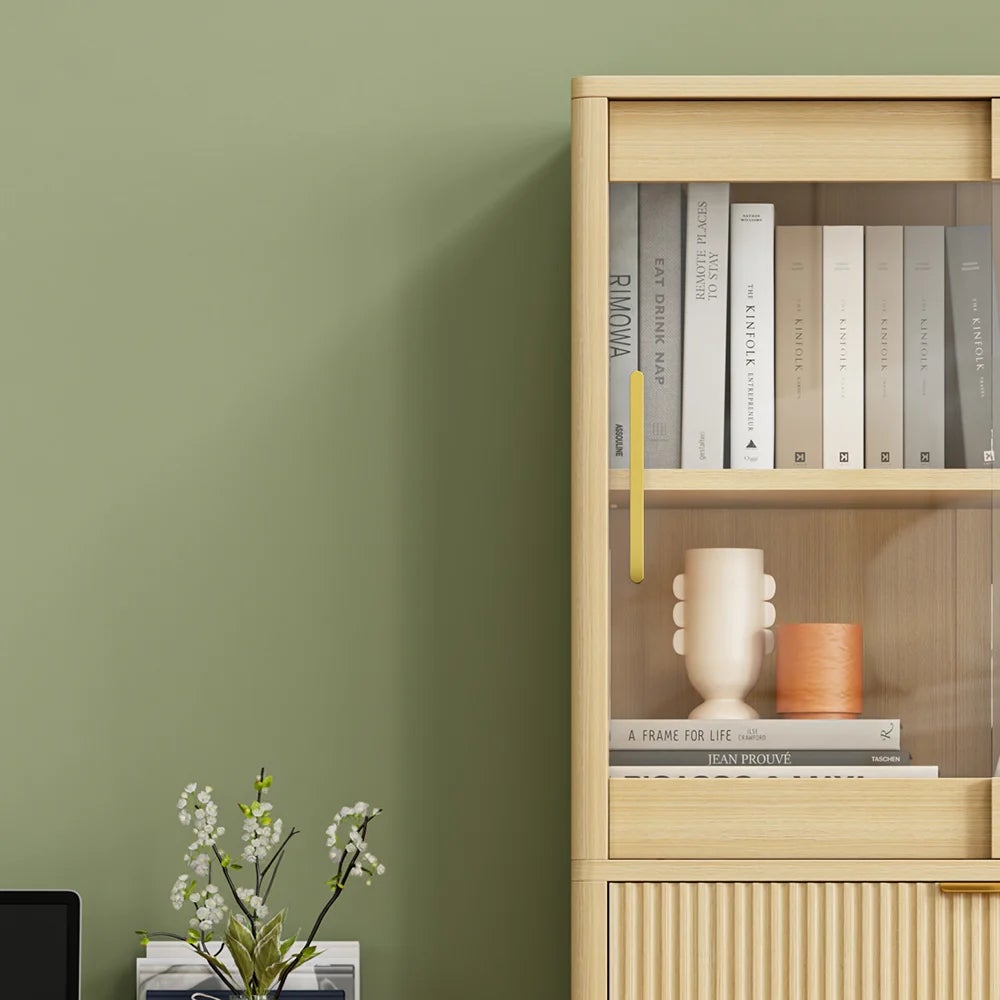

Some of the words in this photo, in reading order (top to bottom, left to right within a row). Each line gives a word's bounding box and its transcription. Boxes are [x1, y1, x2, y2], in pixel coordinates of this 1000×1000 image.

[697, 201, 708, 245] PLACES
[654, 258, 665, 287] EAT
[696, 250, 706, 300] REMOTE
[708, 251, 719, 280] STAY
[708, 282, 718, 300] TO
[609, 274, 632, 358] RIMOWA
[654, 296, 665, 344] DRINK
[746, 305, 756, 366] KINFOLK
[795, 318, 804, 372] KINFOLK
[880, 318, 888, 372] KINFOLK
[920, 318, 928, 372] KINFOLK
[972, 318, 984, 372] KINFOLK
[654, 353, 665, 385] NAP
[615, 424, 623, 457] ASSOULINE
[628, 730, 636, 742] A
[642, 730, 678, 742] FRAME
[684, 730, 704, 742] FOR
[710, 730, 732, 742] LIFE
[708, 754, 738, 764] JEAN
[742, 752, 792, 764] PROUVÉ
